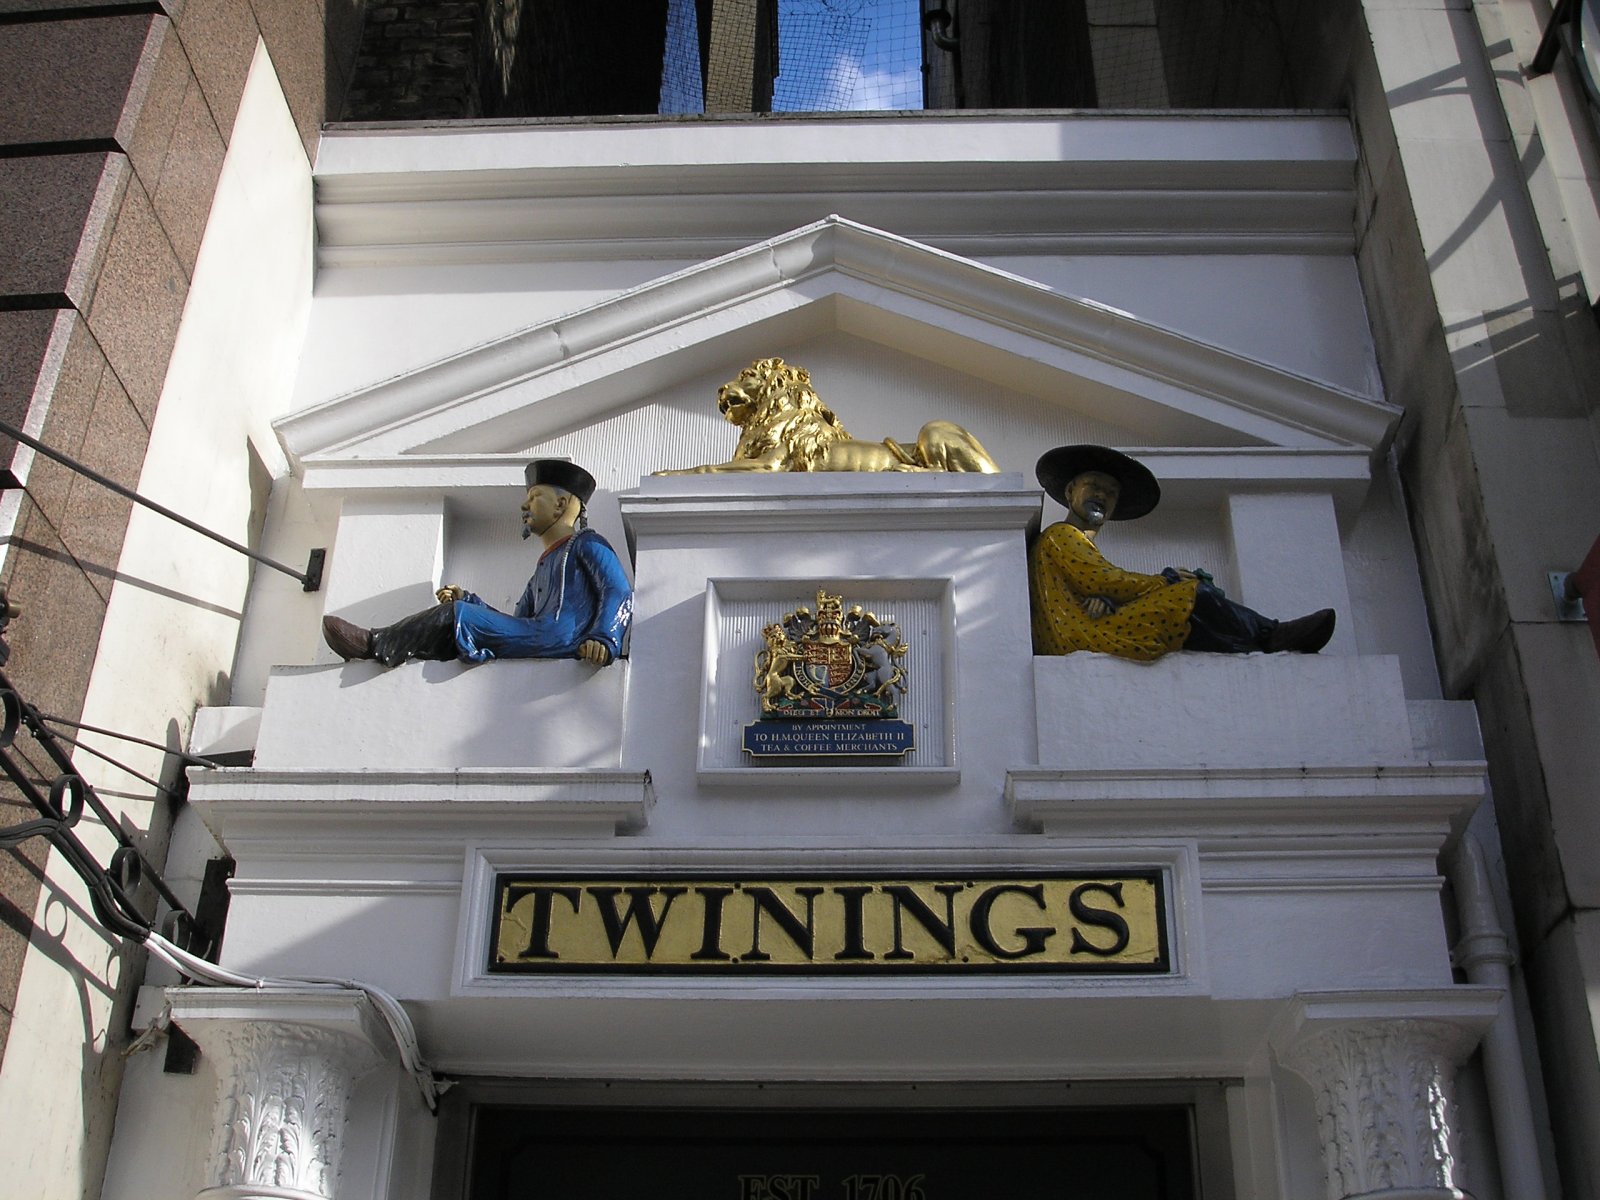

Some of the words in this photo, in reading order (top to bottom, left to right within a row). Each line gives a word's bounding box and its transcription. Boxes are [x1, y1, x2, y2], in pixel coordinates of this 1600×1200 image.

[836, 709, 855, 717] MON
[754, 733, 768, 741] TO
[834, 733, 893, 741] ELIZABETH
[897, 733, 904, 741] II
[761, 743, 781, 752] TEA
[783, 743, 790, 751] &
[794, 743, 832, 752] COFFEE
[836, 743, 897, 751] MERCHANTS
[505, 882, 1131, 960] TWININGS
[737, 1174, 820, 1200] EST
[841, 1174, 926, 1200] 1706
